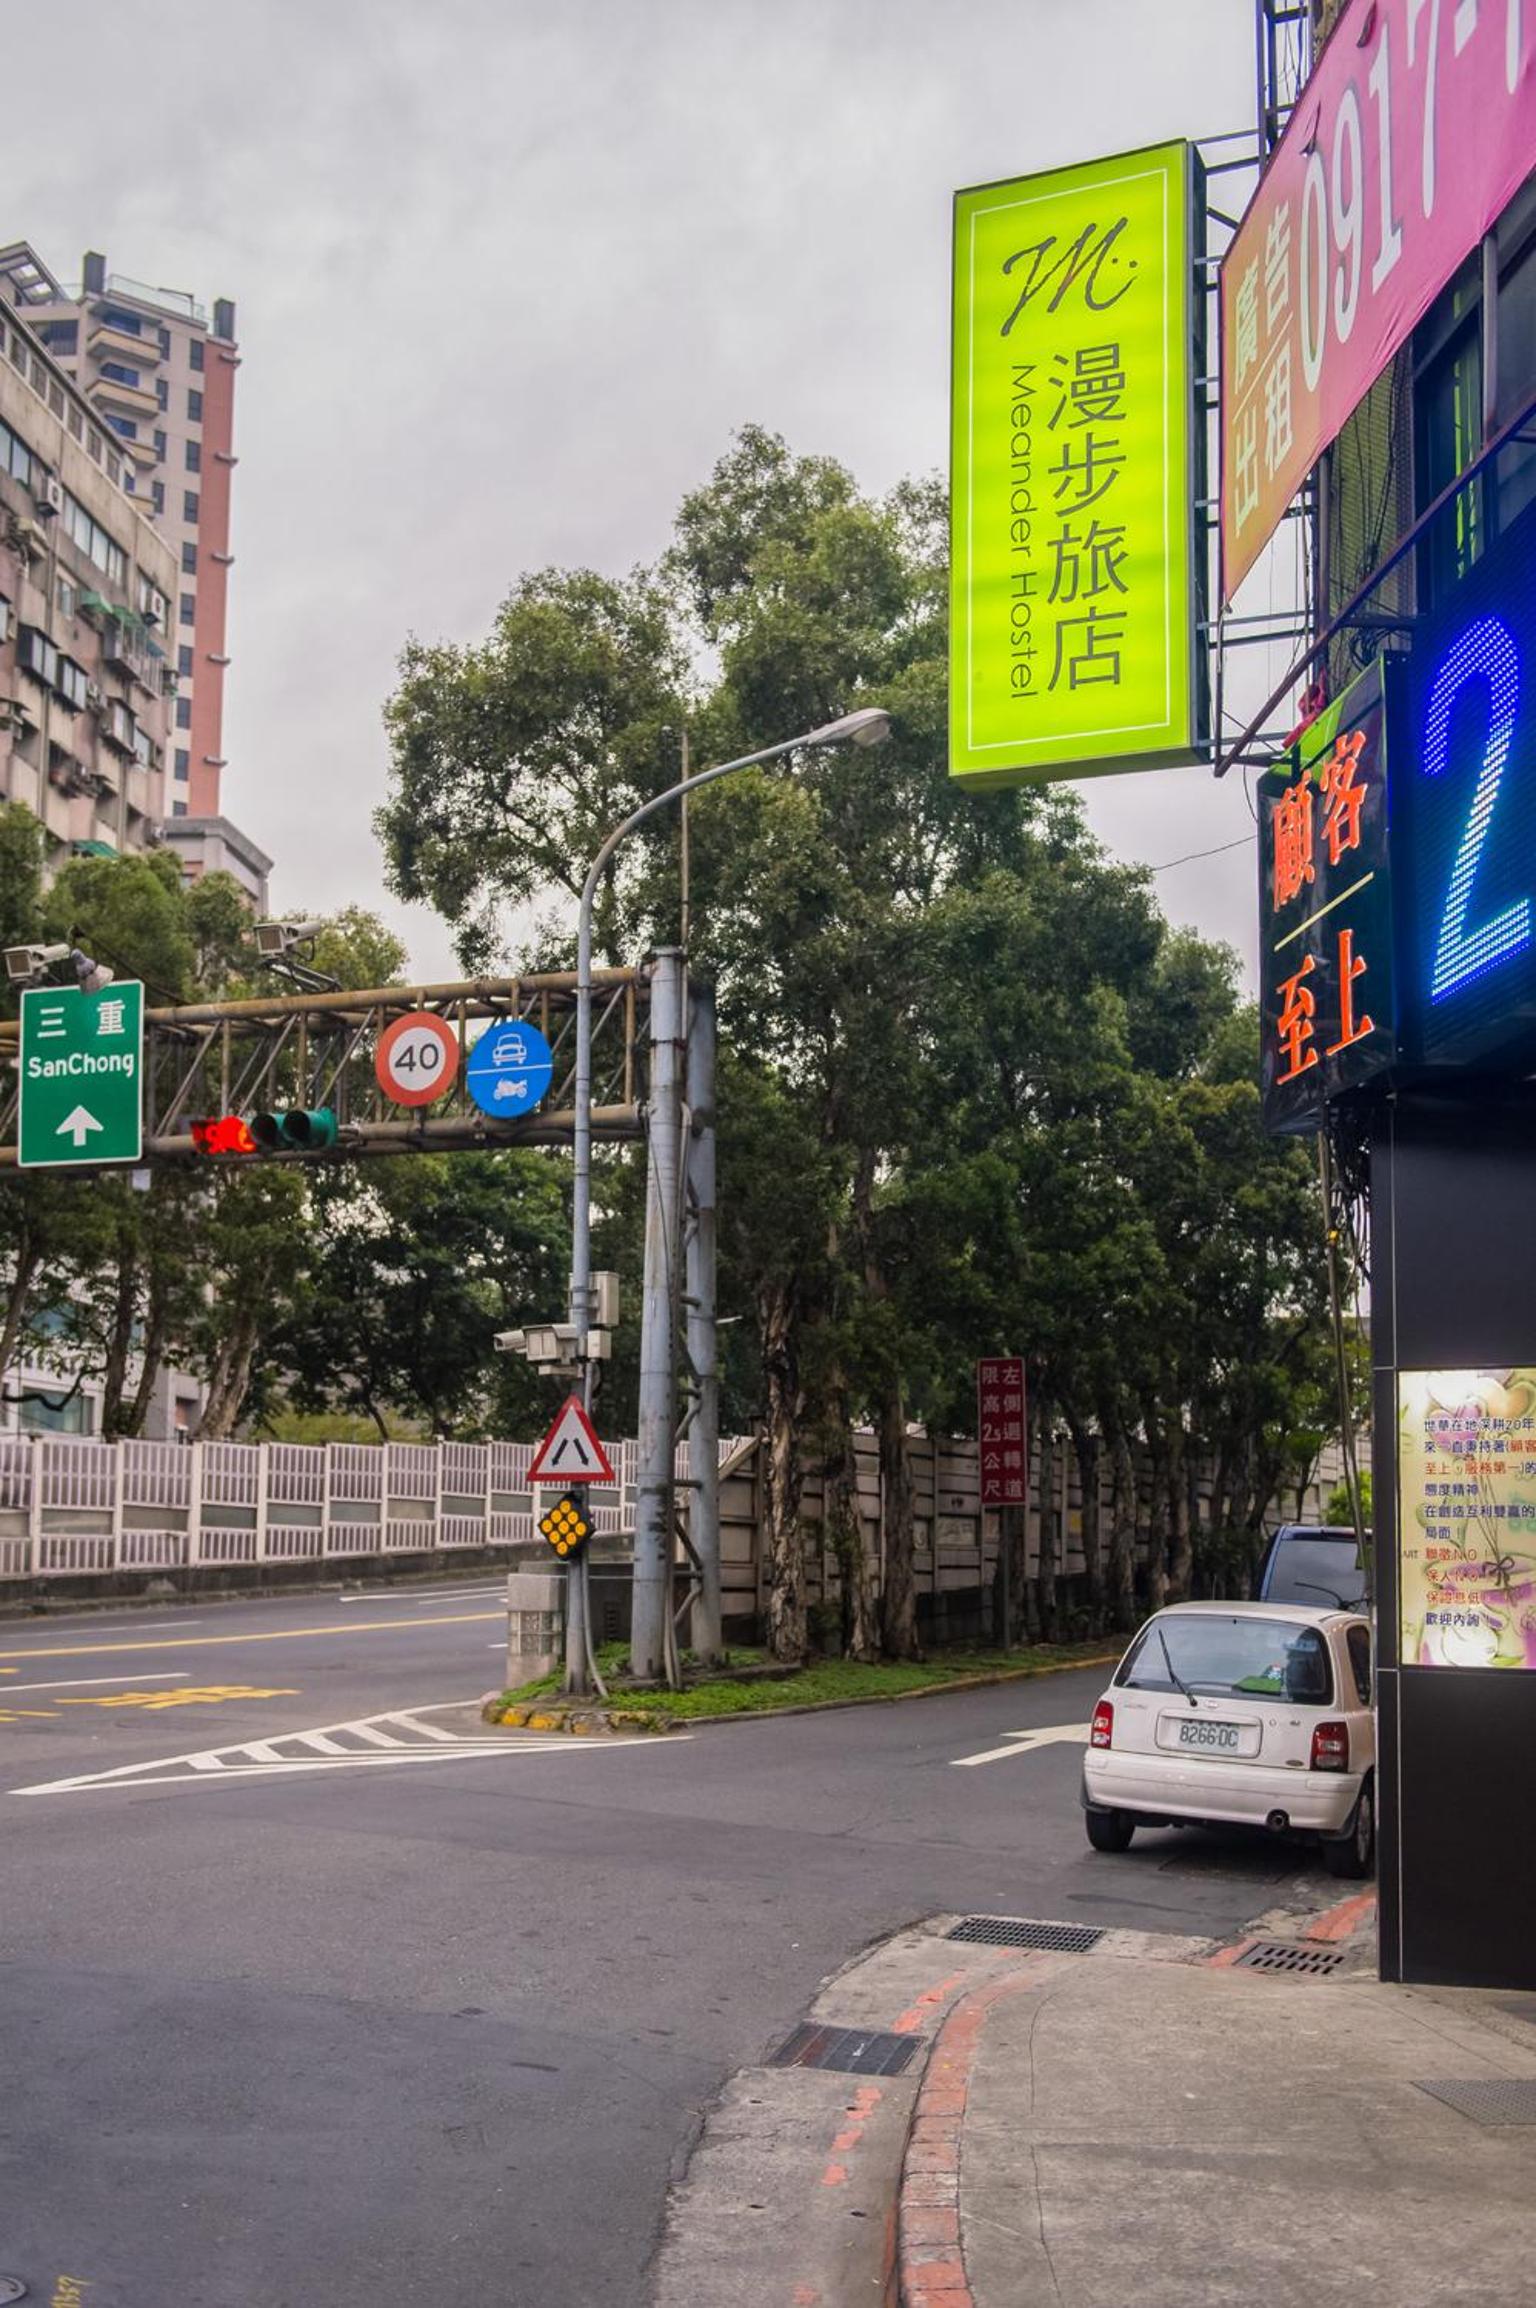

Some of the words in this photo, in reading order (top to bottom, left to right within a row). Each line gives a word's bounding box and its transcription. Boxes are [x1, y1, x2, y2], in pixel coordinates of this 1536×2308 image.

[1235, 200, 1291, 394] 廣告
[1011, 364, 1038, 558] Meander
[1046, 342, 1129, 692] 漫步旅店
[1235, 337, 1293, 537] 出租
[1011, 572, 1038, 698] Hostel
[1272, 730, 1369, 914] 顧客
[1423, 617, 1531, 998] 2
[27, 1052, 135, 1079] SanChong
[37, 1000, 125, 1039] 三重
[394, 1043, 439, 1072] 40
[1275, 928, 1375, 1086] 至上
